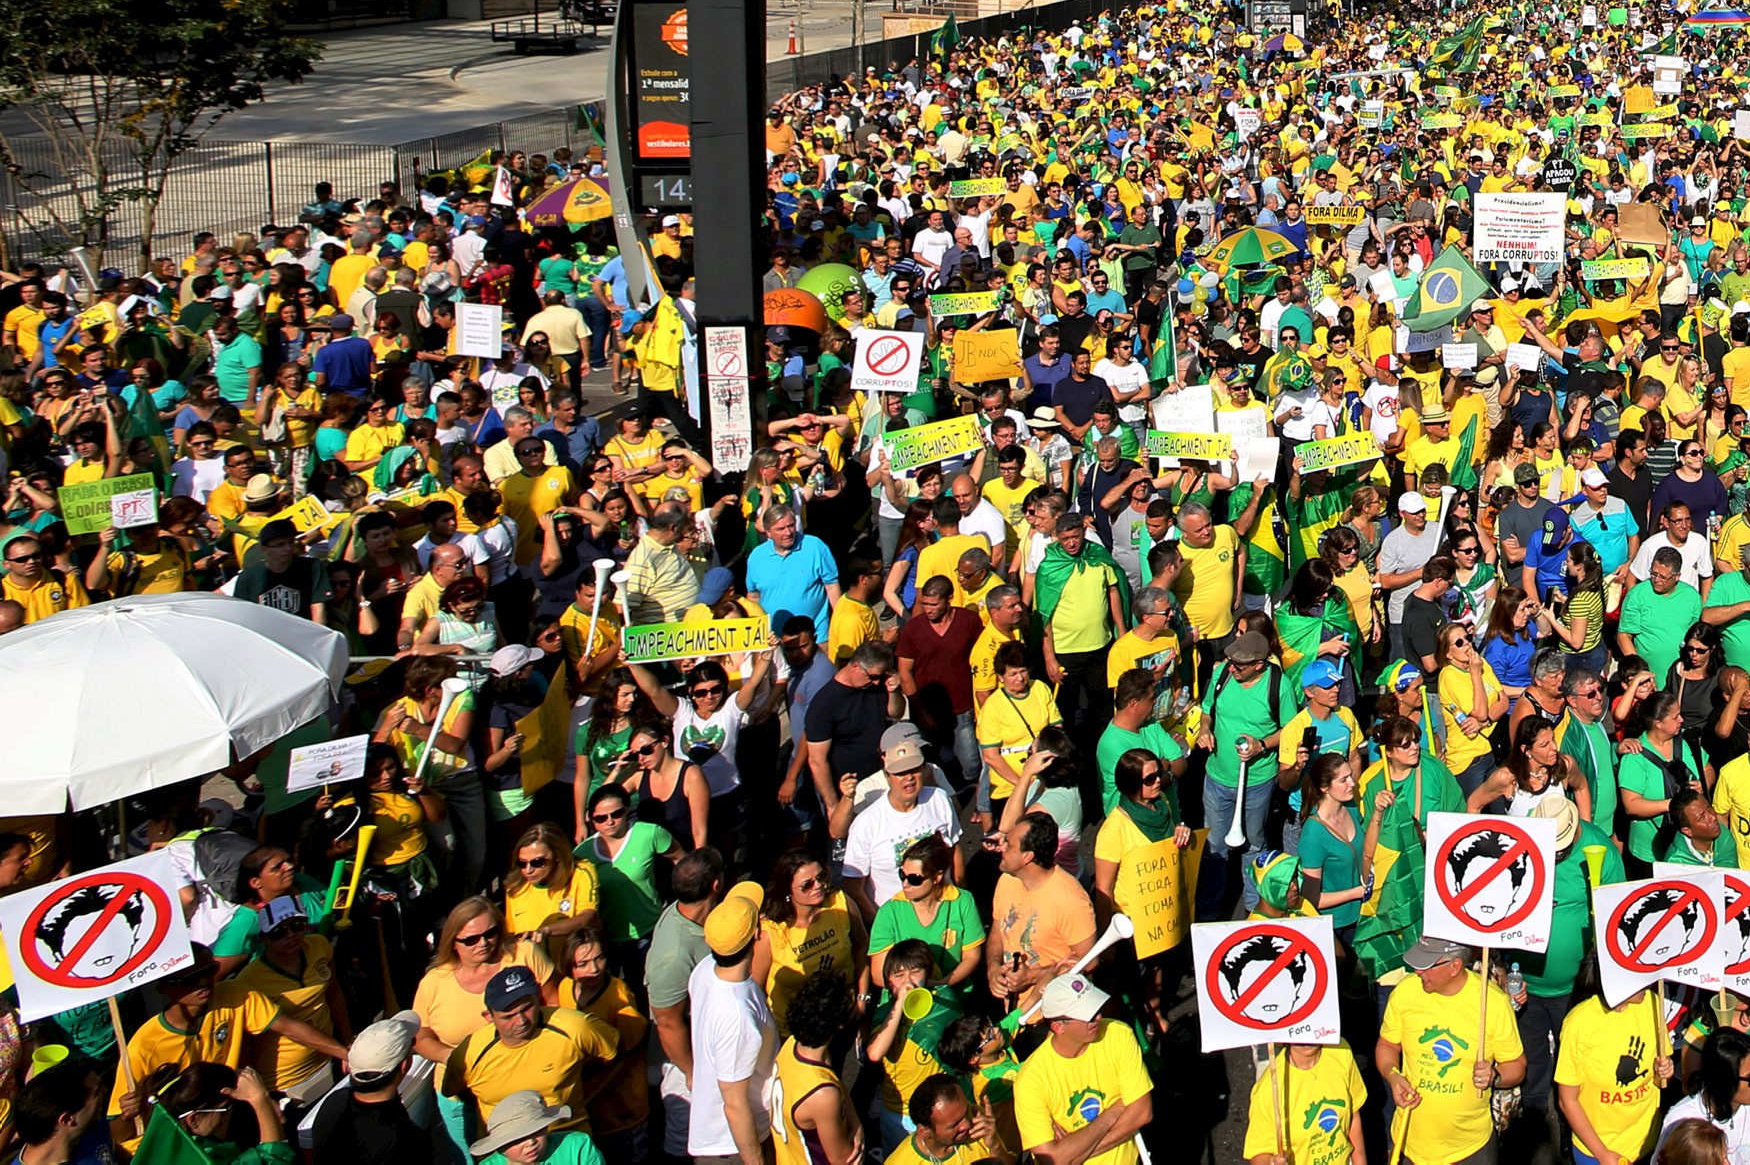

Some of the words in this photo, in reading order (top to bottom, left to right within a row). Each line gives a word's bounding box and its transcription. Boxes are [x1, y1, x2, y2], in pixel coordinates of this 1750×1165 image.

[653, 78, 689, 89] mensalid
[1552, 159, 1564, 169] PT
[1545, 169, 1574, 178] APAGOU
[1551, 177, 1572, 185] BRASIL
[654, 179, 694, 201] 14:
[1308, 207, 1331, 217] FORA
[1333, 207, 1358, 219] DILMA
[1496, 240, 1537, 249] NENHUM!
[1479, 250, 1499, 260] FORA
[1502, 250, 1558, 261] CORRUPTOS!
[1584, 262, 1632, 277] IMPEACHMENT
[932, 296, 982, 314] IMPEACHMENT
[855, 377, 914, 389] CORRUPTOS!
[892, 431, 962, 469] IMPEACHMENT
[1148, 434, 1212, 455] IMPEACHMENT
[1303, 439, 1361, 468] IMPEACHMENT
[121, 501, 139, 516] PT
[626, 627, 735, 660] IMPEACHMENT
[741, 620, 768, 648] JÁ!
[1136, 856, 1168, 877] FORA
[1138, 875, 1172, 895] FORA
[1142, 896, 1174, 917] TOMA
[792, 928, 837, 955] PETROLÃO
[1148, 925, 1164, 942] NA
[1501, 929, 1523, 943] Fora
[1524, 934, 1545, 945] Dilma
[128, 961, 159, 984] Fora
[160, 953, 191, 973] Dilma
[1677, 967, 1698, 977] Fora
[1699, 973, 1721, 984] Dilma
[1288, 1024, 1312, 1038] Fora
[1313, 1027, 1338, 1039] Dilma
[1418, 1078, 1464, 1094] BRASIL!
